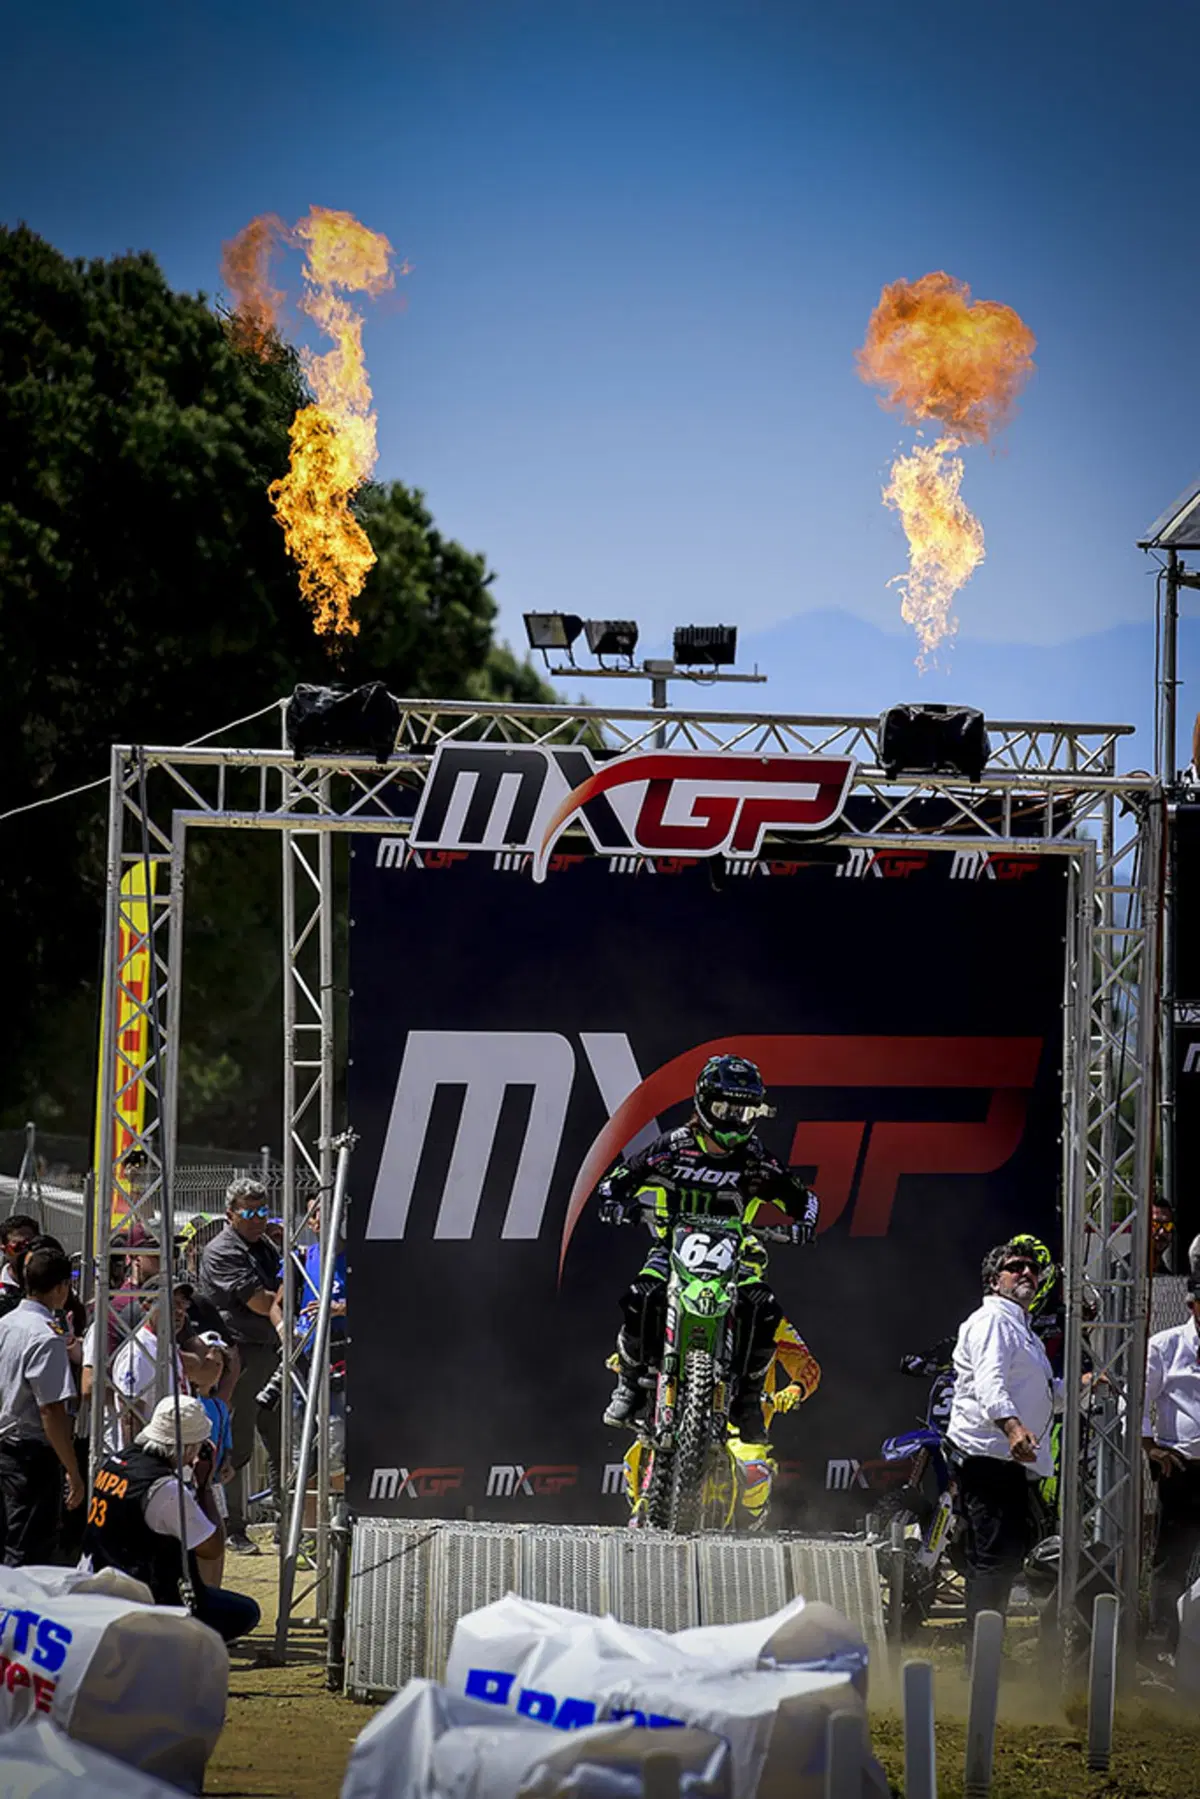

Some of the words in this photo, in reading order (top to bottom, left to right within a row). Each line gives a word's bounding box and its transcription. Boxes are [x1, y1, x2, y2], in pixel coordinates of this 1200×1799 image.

[412, 744, 855, 878] MXGP
[949, 849, 1040, 881] MXGP
[672, 1164, 741, 1188] THOR
[679, 1232, 735, 1271] 64
[369, 1467, 464, 1500] MXGP
[486, 1464, 578, 1499] MXGP
[0, 1608, 74, 1674] TS
